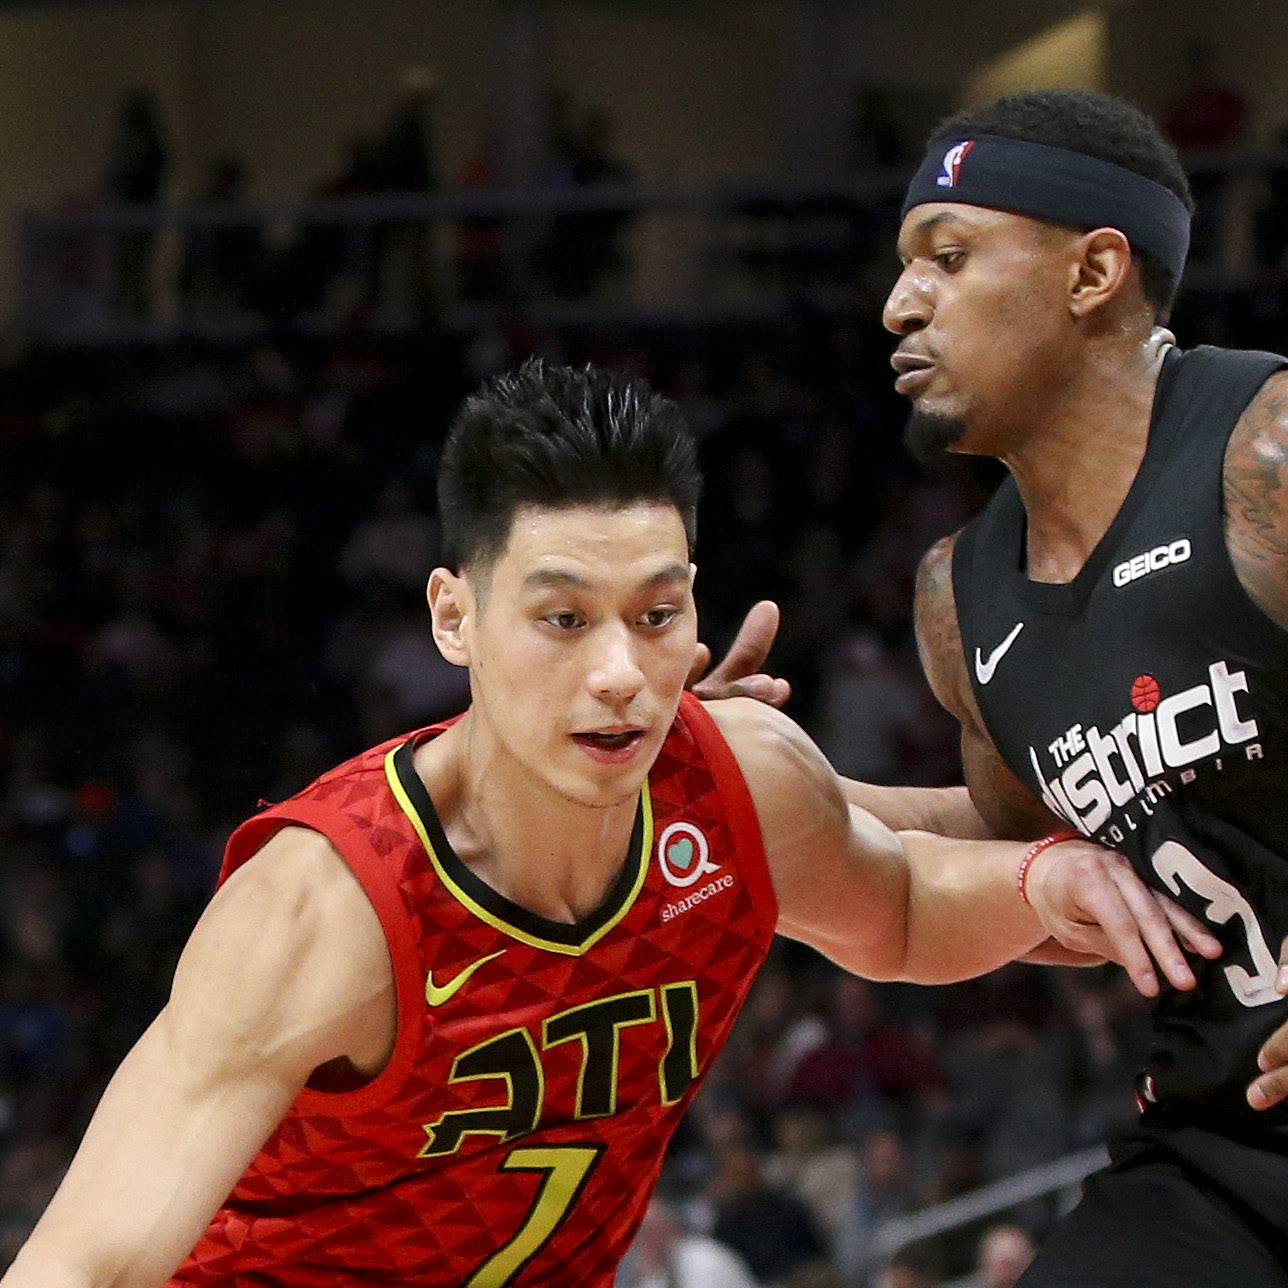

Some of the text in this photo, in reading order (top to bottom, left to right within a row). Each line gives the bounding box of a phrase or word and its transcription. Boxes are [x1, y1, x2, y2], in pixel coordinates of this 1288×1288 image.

[1113, 538, 1192, 588] GEICO
[1048, 723, 1086, 769] THE
[662, 874, 734, 923] sharecare
[1151, 840, 1285, 1008] 3
